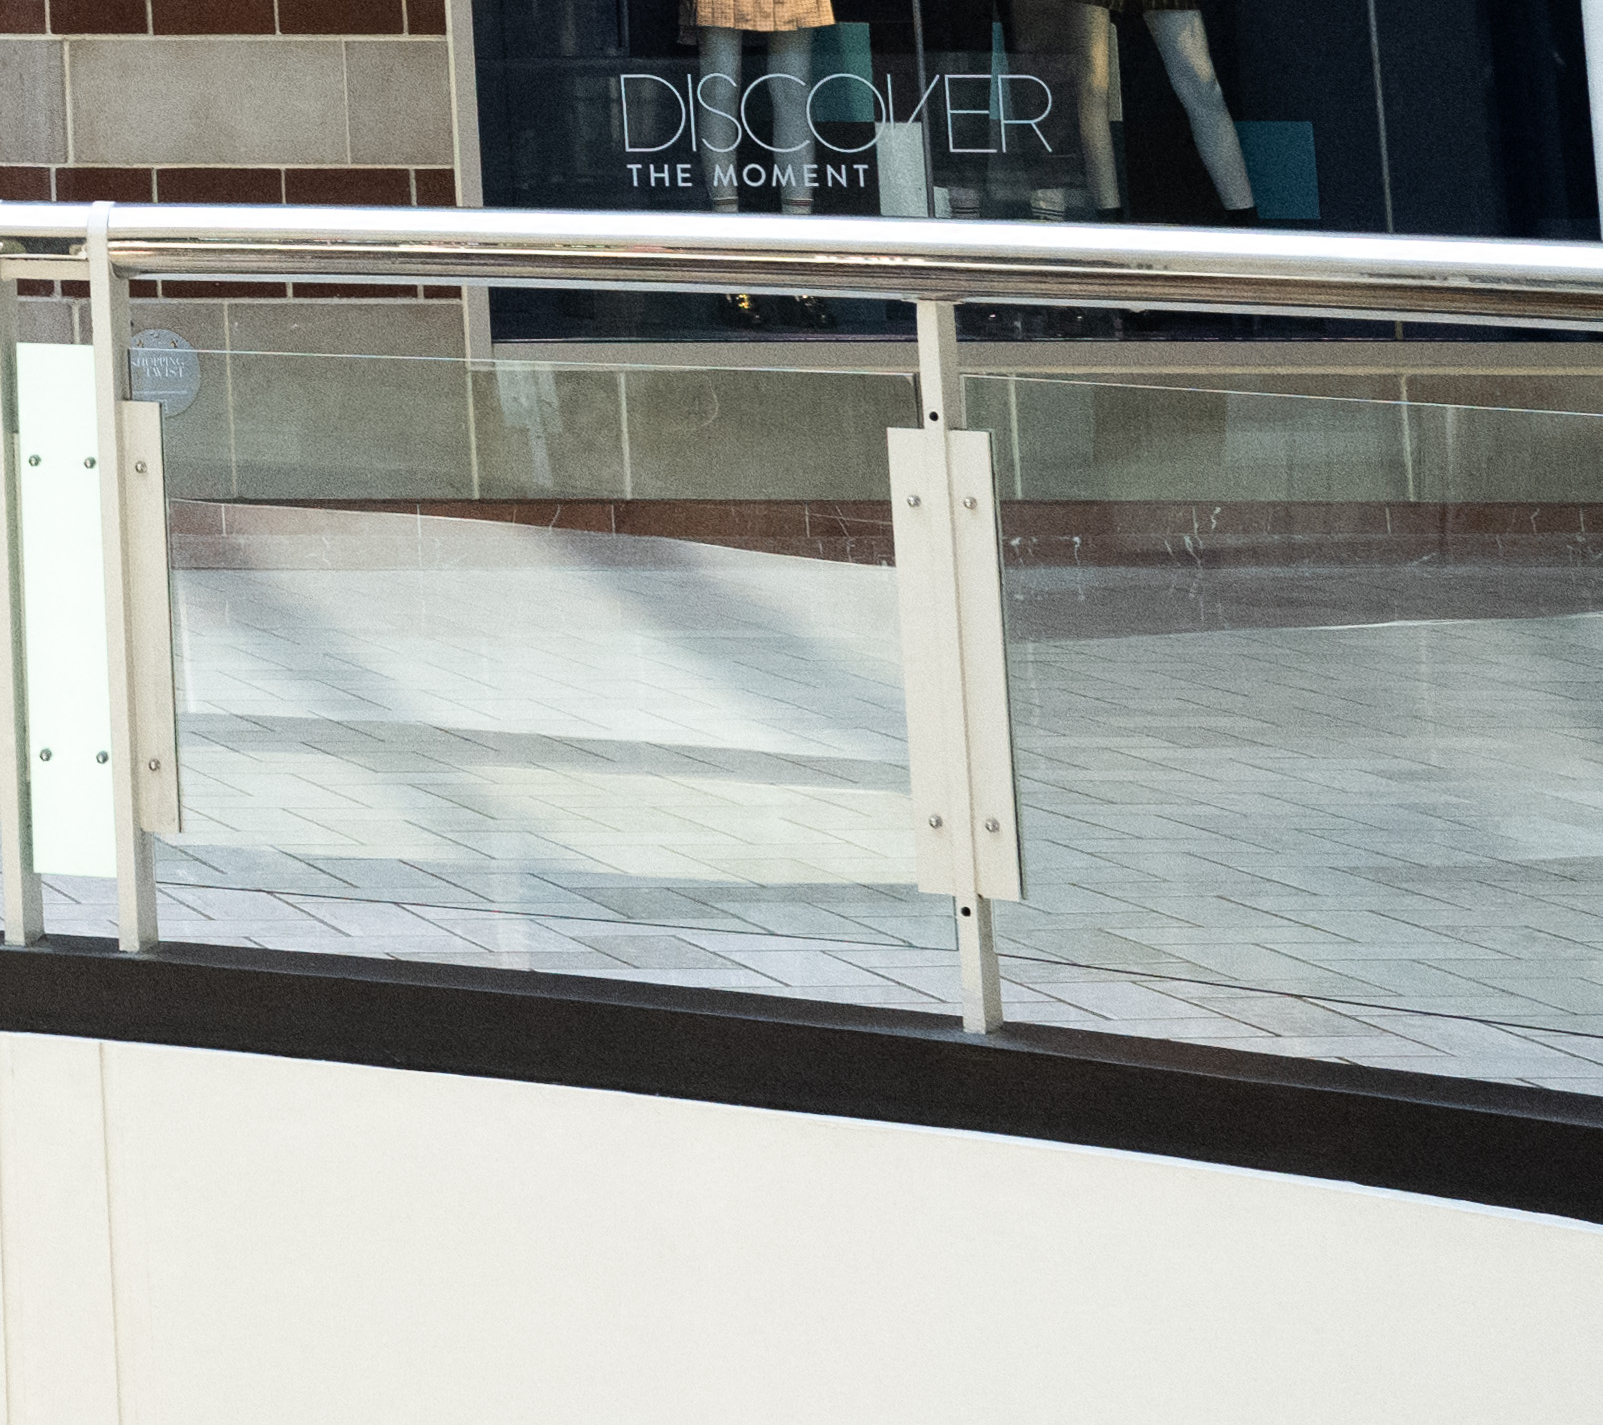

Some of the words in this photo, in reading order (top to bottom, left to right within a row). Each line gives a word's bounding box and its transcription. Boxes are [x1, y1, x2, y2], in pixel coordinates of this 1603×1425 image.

[620, 73, 1053, 153] DISCOVER
[626, 163, 693, 188] THE
[713, 163, 869, 189] MOMENT
